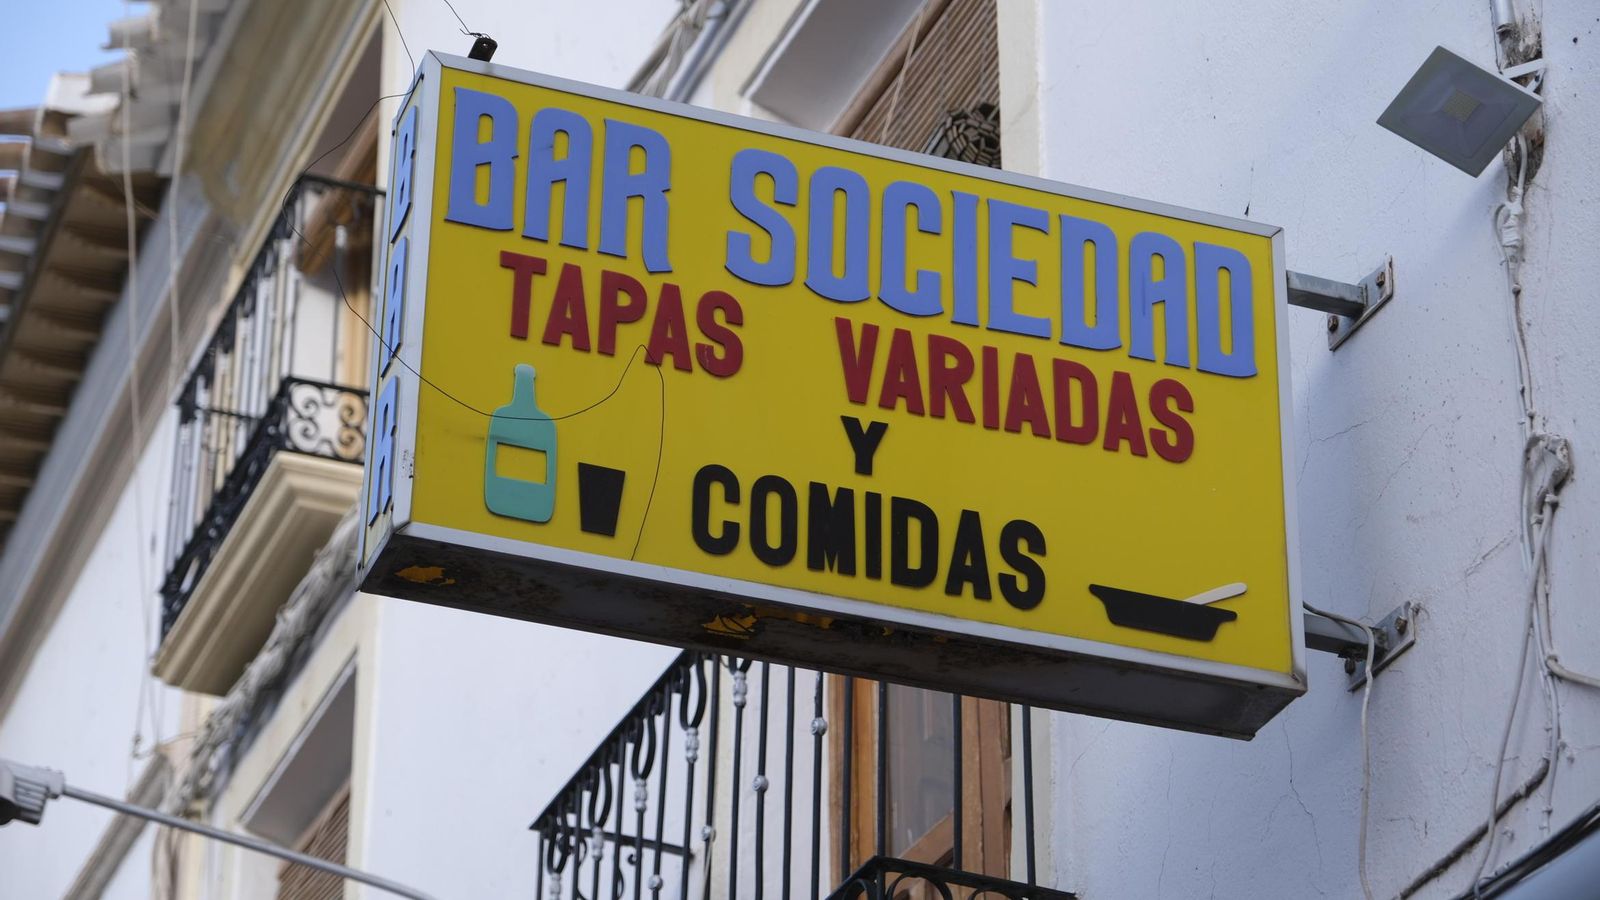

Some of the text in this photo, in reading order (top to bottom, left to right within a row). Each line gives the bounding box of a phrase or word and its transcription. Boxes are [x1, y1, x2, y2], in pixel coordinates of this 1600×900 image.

[369, 105, 418, 526] BAR
[446, 87, 1258, 378] BAR SOCIEDAD
[500, 251, 1194, 463] TAPAS VARIADAS
[840, 415, 889, 476] Y
[691, 464, 1047, 611] COMIDAS
